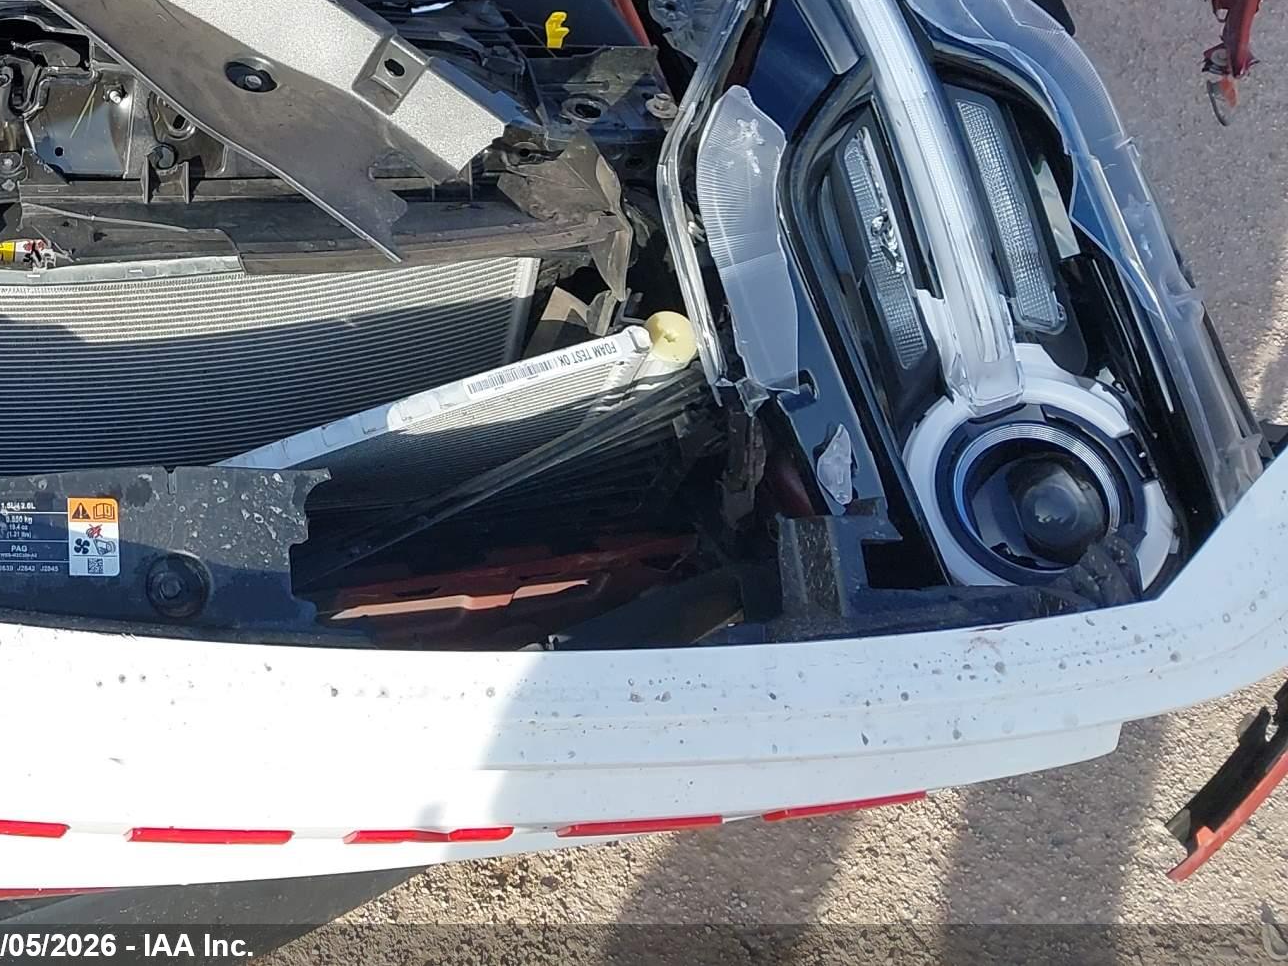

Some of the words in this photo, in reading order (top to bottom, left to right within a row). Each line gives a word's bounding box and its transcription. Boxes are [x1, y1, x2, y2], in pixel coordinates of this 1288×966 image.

[572, 349, 593, 364] TEST
[592, 342, 617, 358] FOAM
[557, 355, 571, 367] OK
[24, 515, 33, 525] kg
